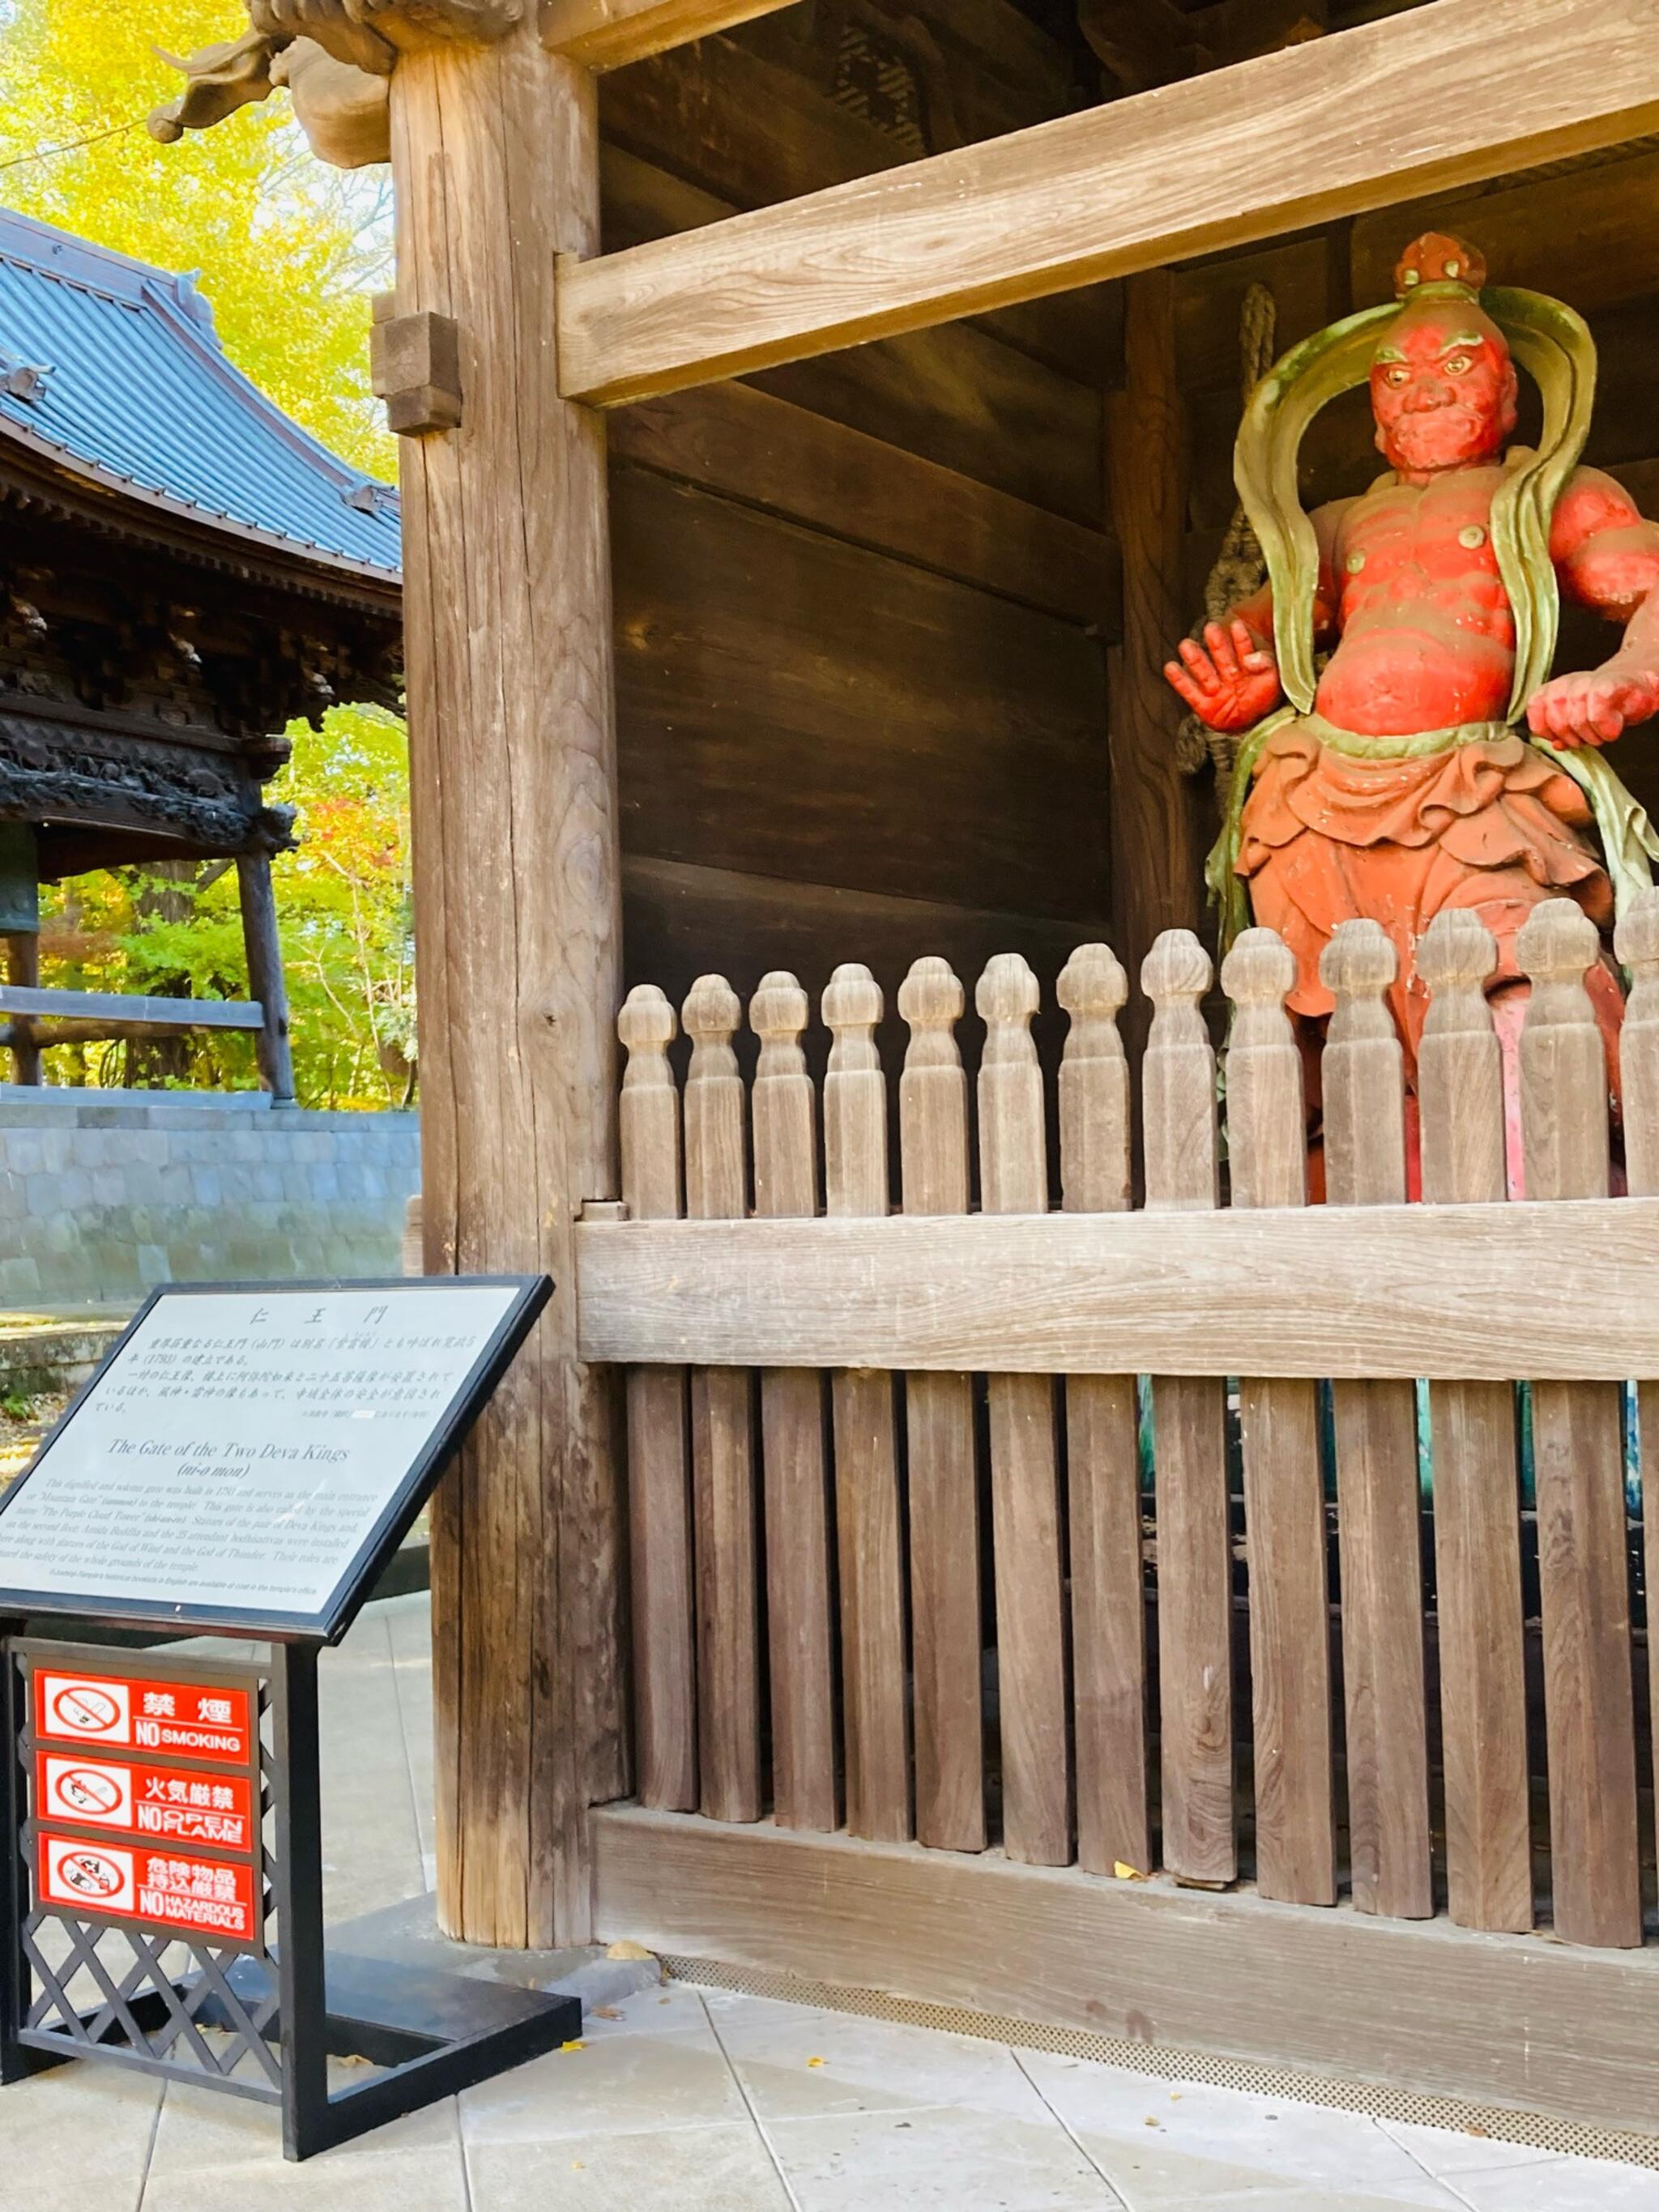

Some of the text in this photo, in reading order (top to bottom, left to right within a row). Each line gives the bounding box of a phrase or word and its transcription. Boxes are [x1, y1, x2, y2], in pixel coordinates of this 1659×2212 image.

[107, 1438, 350, 1463] The Gate of the Two Deva Kings
[177, 1461, 250, 1478] (ni-o mon)
[143, 1692, 232, 1724] 禁煙
[136, 1721, 241, 1752] NO SMOKING
[145, 1776, 233, 1810] 火気厳禁
[138, 1805, 242, 1832] NO OPEN
[164, 1820, 242, 1844] FLAME
[139, 1888, 244, 1919] NO HAZARDOUS
[165, 1907, 245, 1931] MATERIALS
